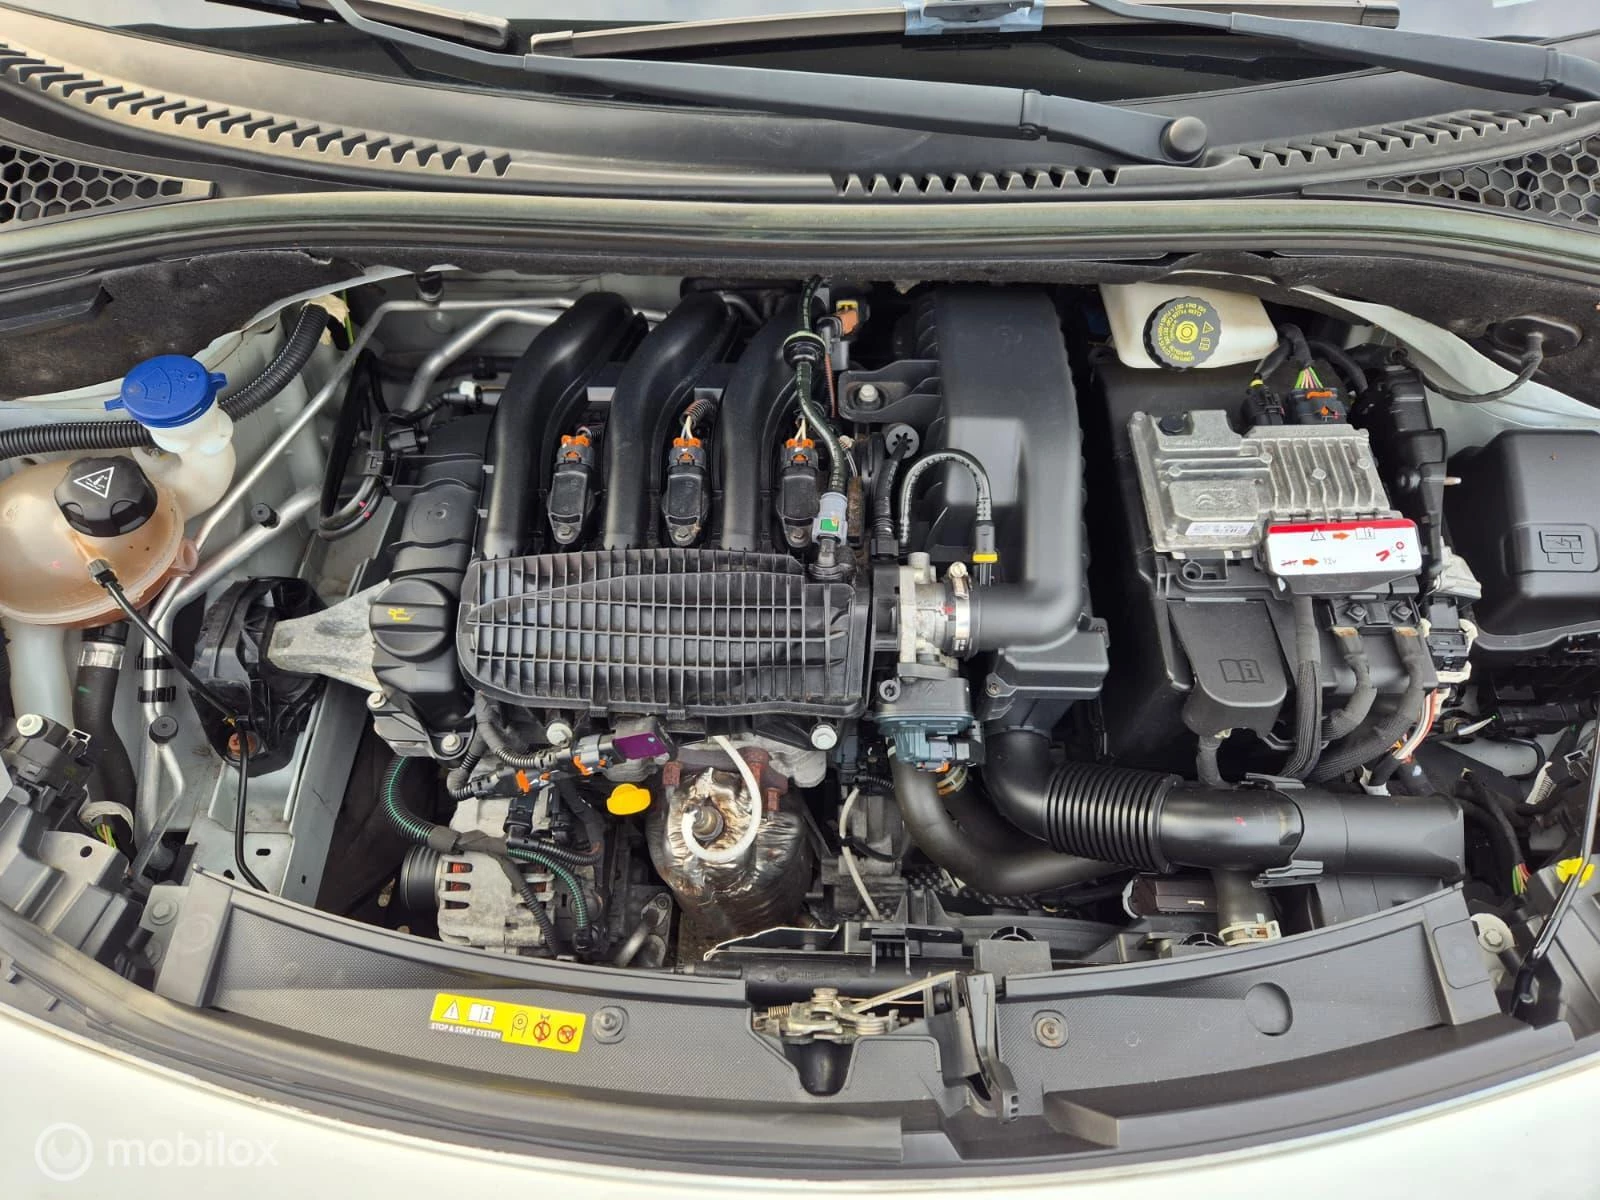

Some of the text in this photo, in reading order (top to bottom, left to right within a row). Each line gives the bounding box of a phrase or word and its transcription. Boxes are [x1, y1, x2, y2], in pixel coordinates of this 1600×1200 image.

[429, 1022, 449, 1031] STOP
[454, 1025, 475, 1035] START
[476, 1028, 502, 1039] SYSTEM
